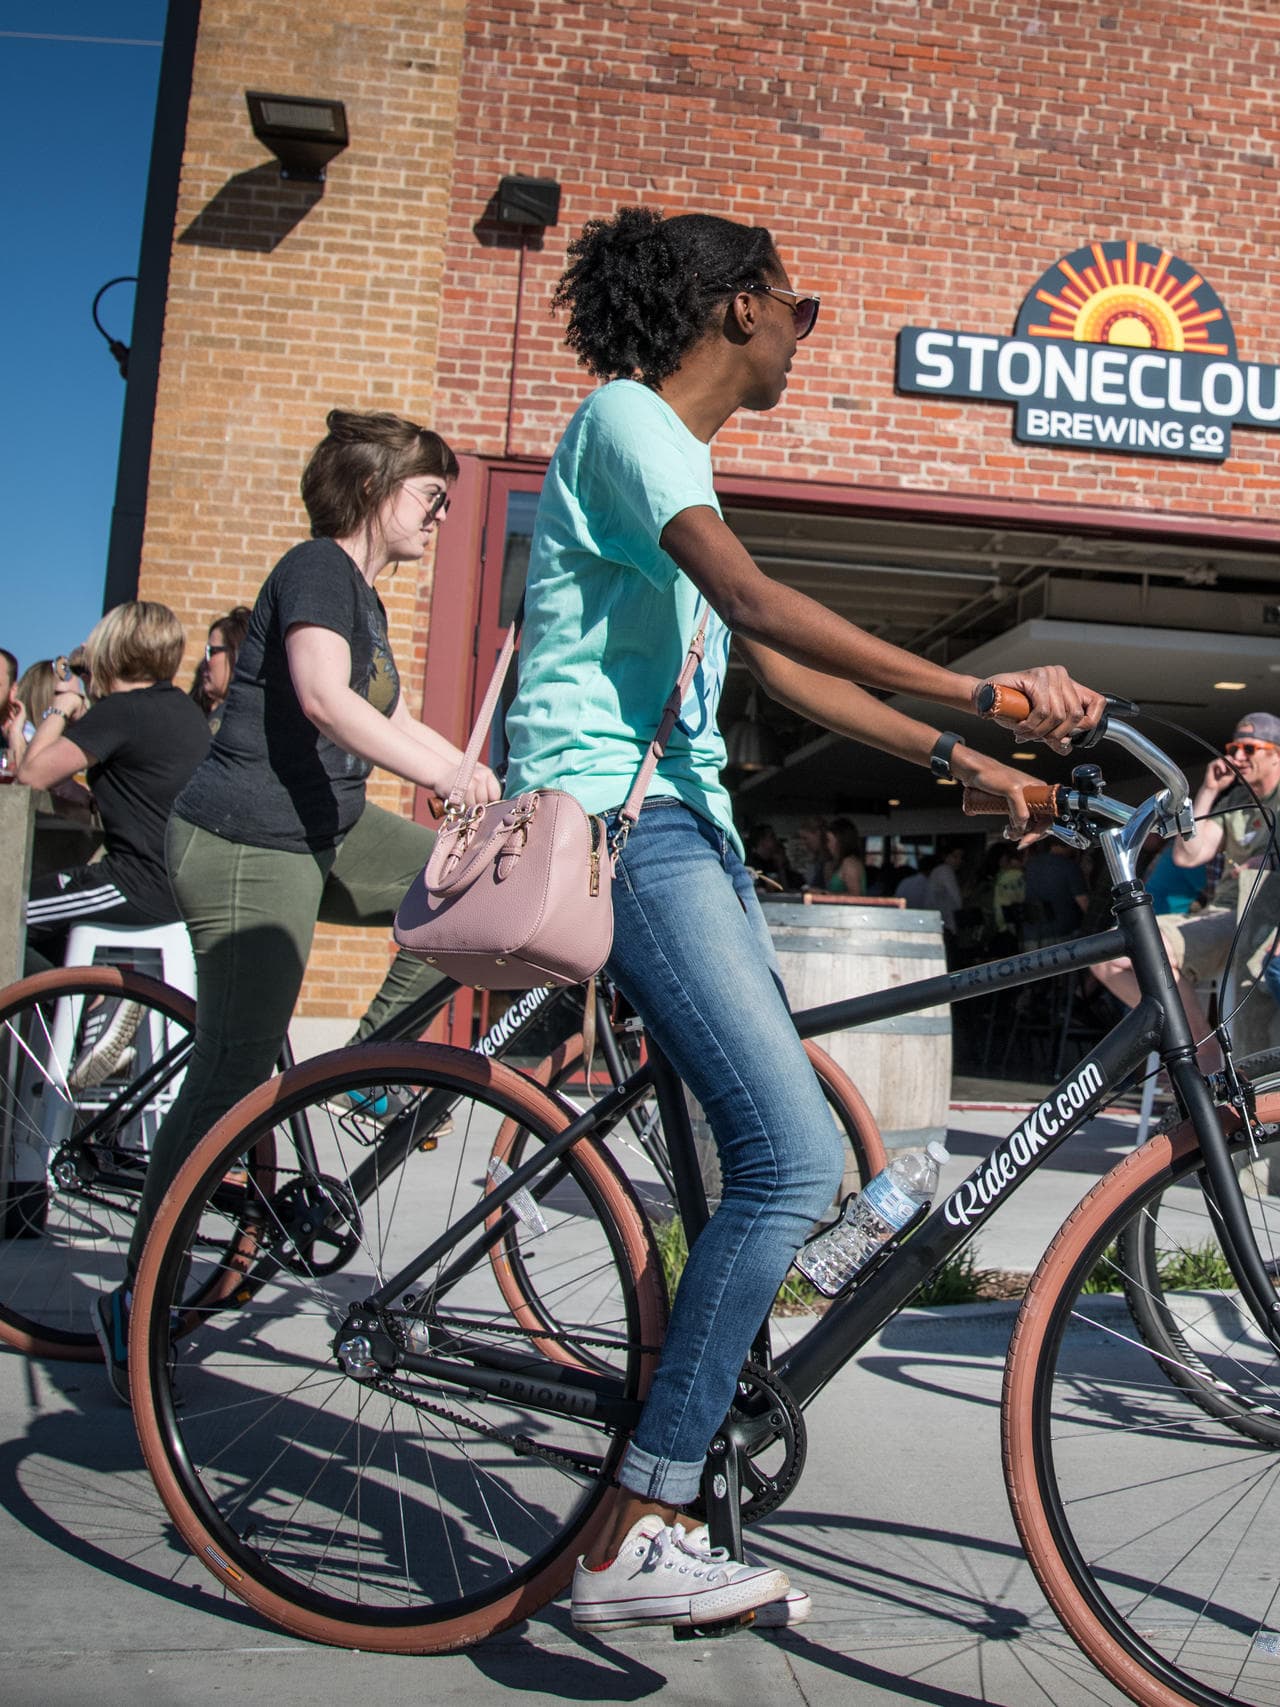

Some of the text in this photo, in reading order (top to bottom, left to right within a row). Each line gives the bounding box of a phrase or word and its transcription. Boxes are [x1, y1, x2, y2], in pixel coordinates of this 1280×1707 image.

[1027, 409, 1184, 449] BREWING
[950, 943, 1078, 990] PRIORITY
[944, 1062, 1103, 1226] RideOKC.com
